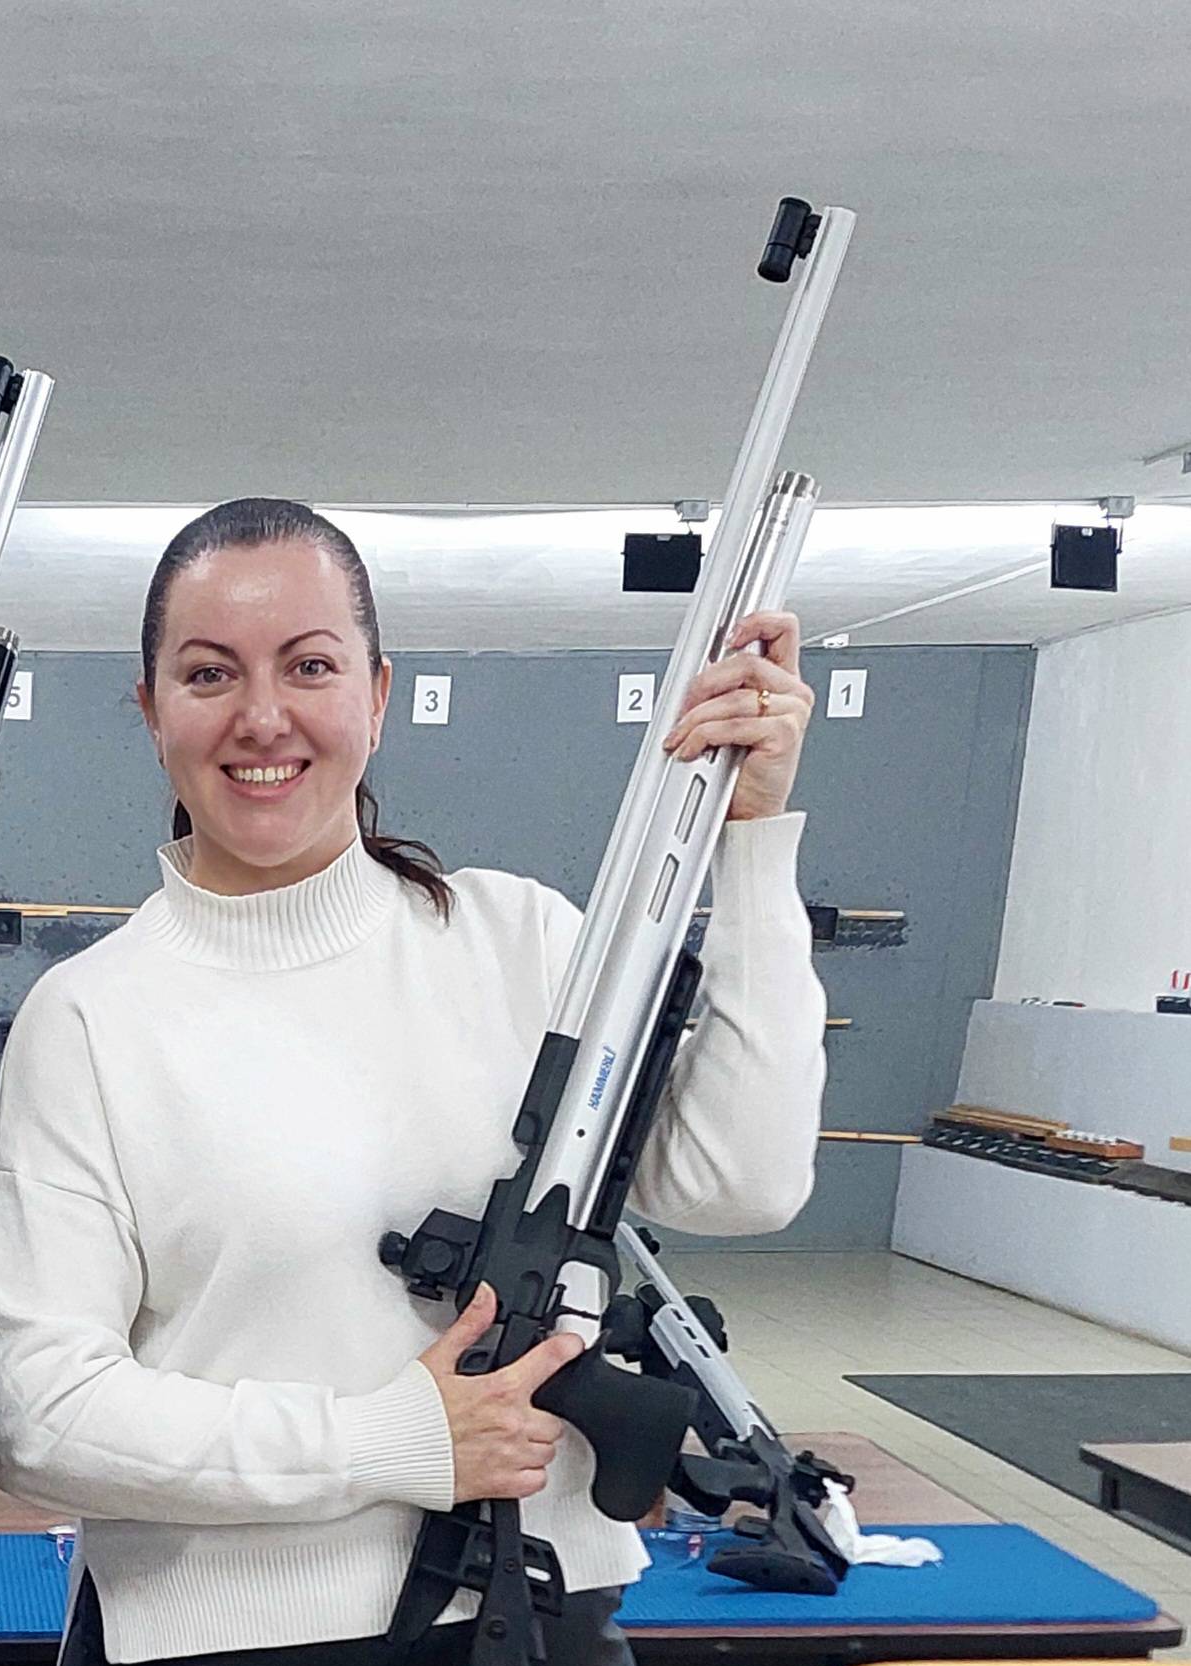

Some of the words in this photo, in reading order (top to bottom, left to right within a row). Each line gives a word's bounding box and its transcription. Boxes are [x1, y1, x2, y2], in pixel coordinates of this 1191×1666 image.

[6, 686, 21, 708] 5
[425, 690, 439, 712] 3
[627, 689, 643, 711] 2
[840, 683, 852, 706] 1
